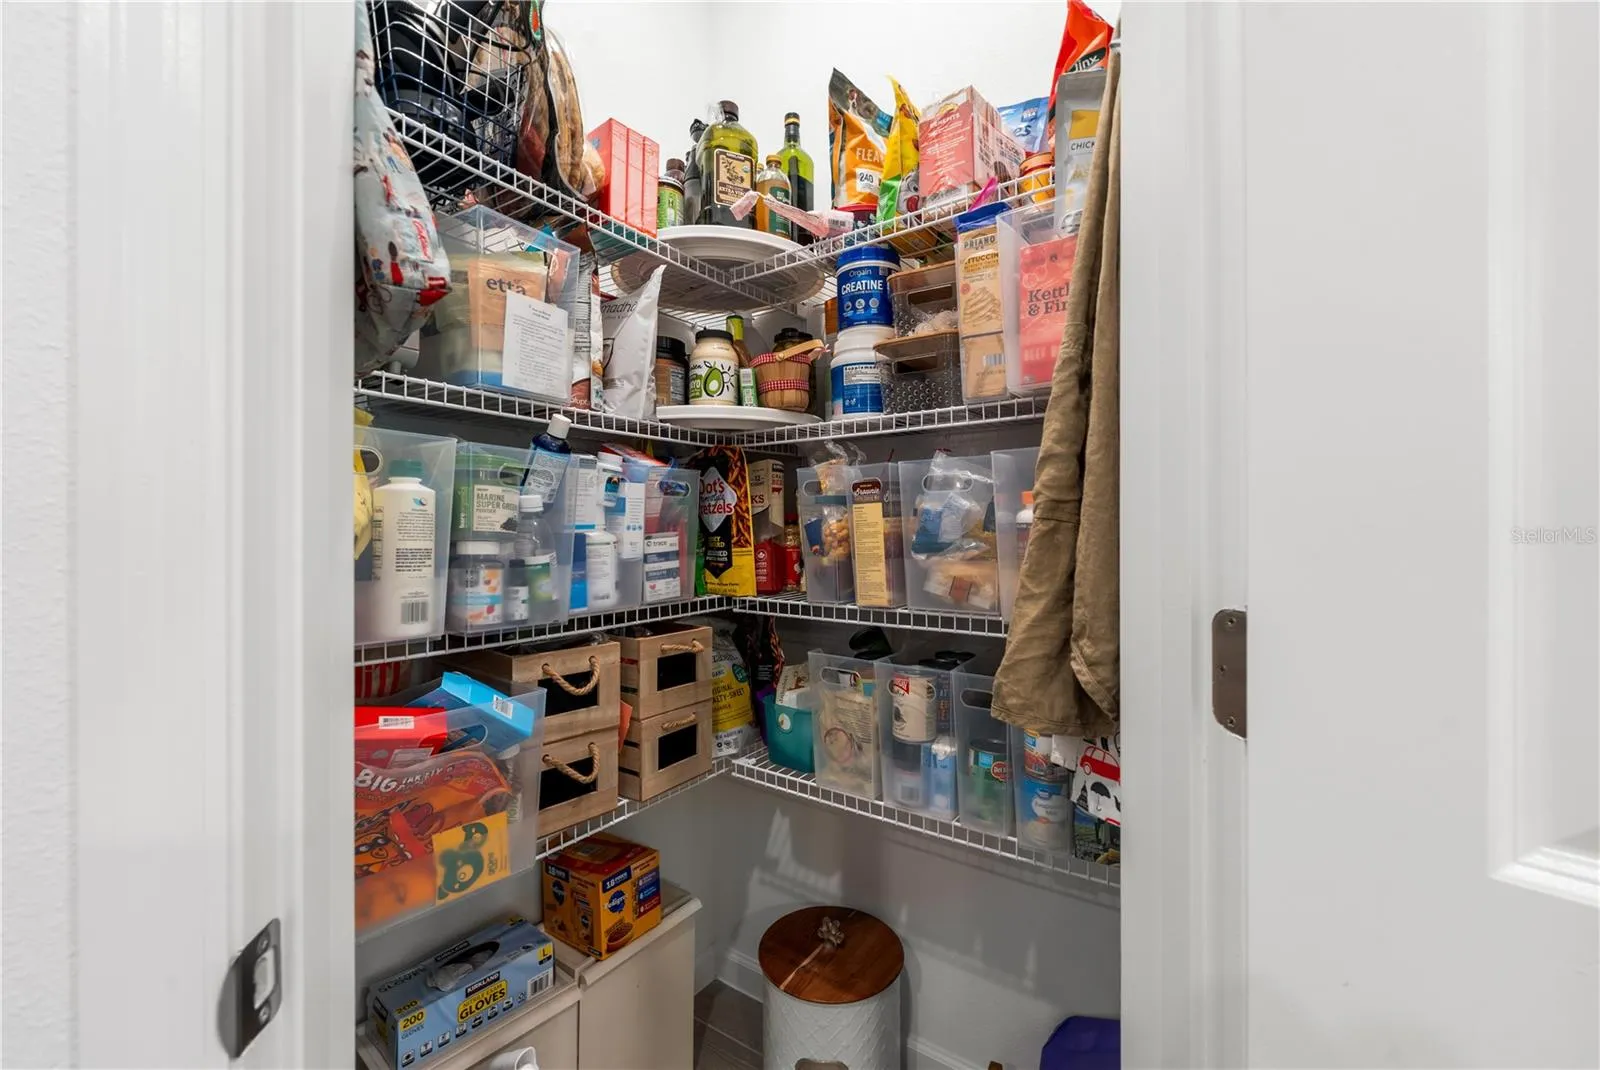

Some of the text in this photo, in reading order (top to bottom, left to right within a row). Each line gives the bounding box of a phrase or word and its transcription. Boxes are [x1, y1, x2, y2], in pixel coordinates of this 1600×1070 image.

[859, 172, 875, 183] 240
[849, 268, 873, 278] Orgain
[841, 280, 884, 296] CREATINE
[1027, 304, 1041, 317] &
[355, 768, 398, 793] BIG
[466, 972, 500, 995] KIRKLAND
[459, 989, 506, 1020] GLOVES
[402, 1010, 424, 1030] 200
